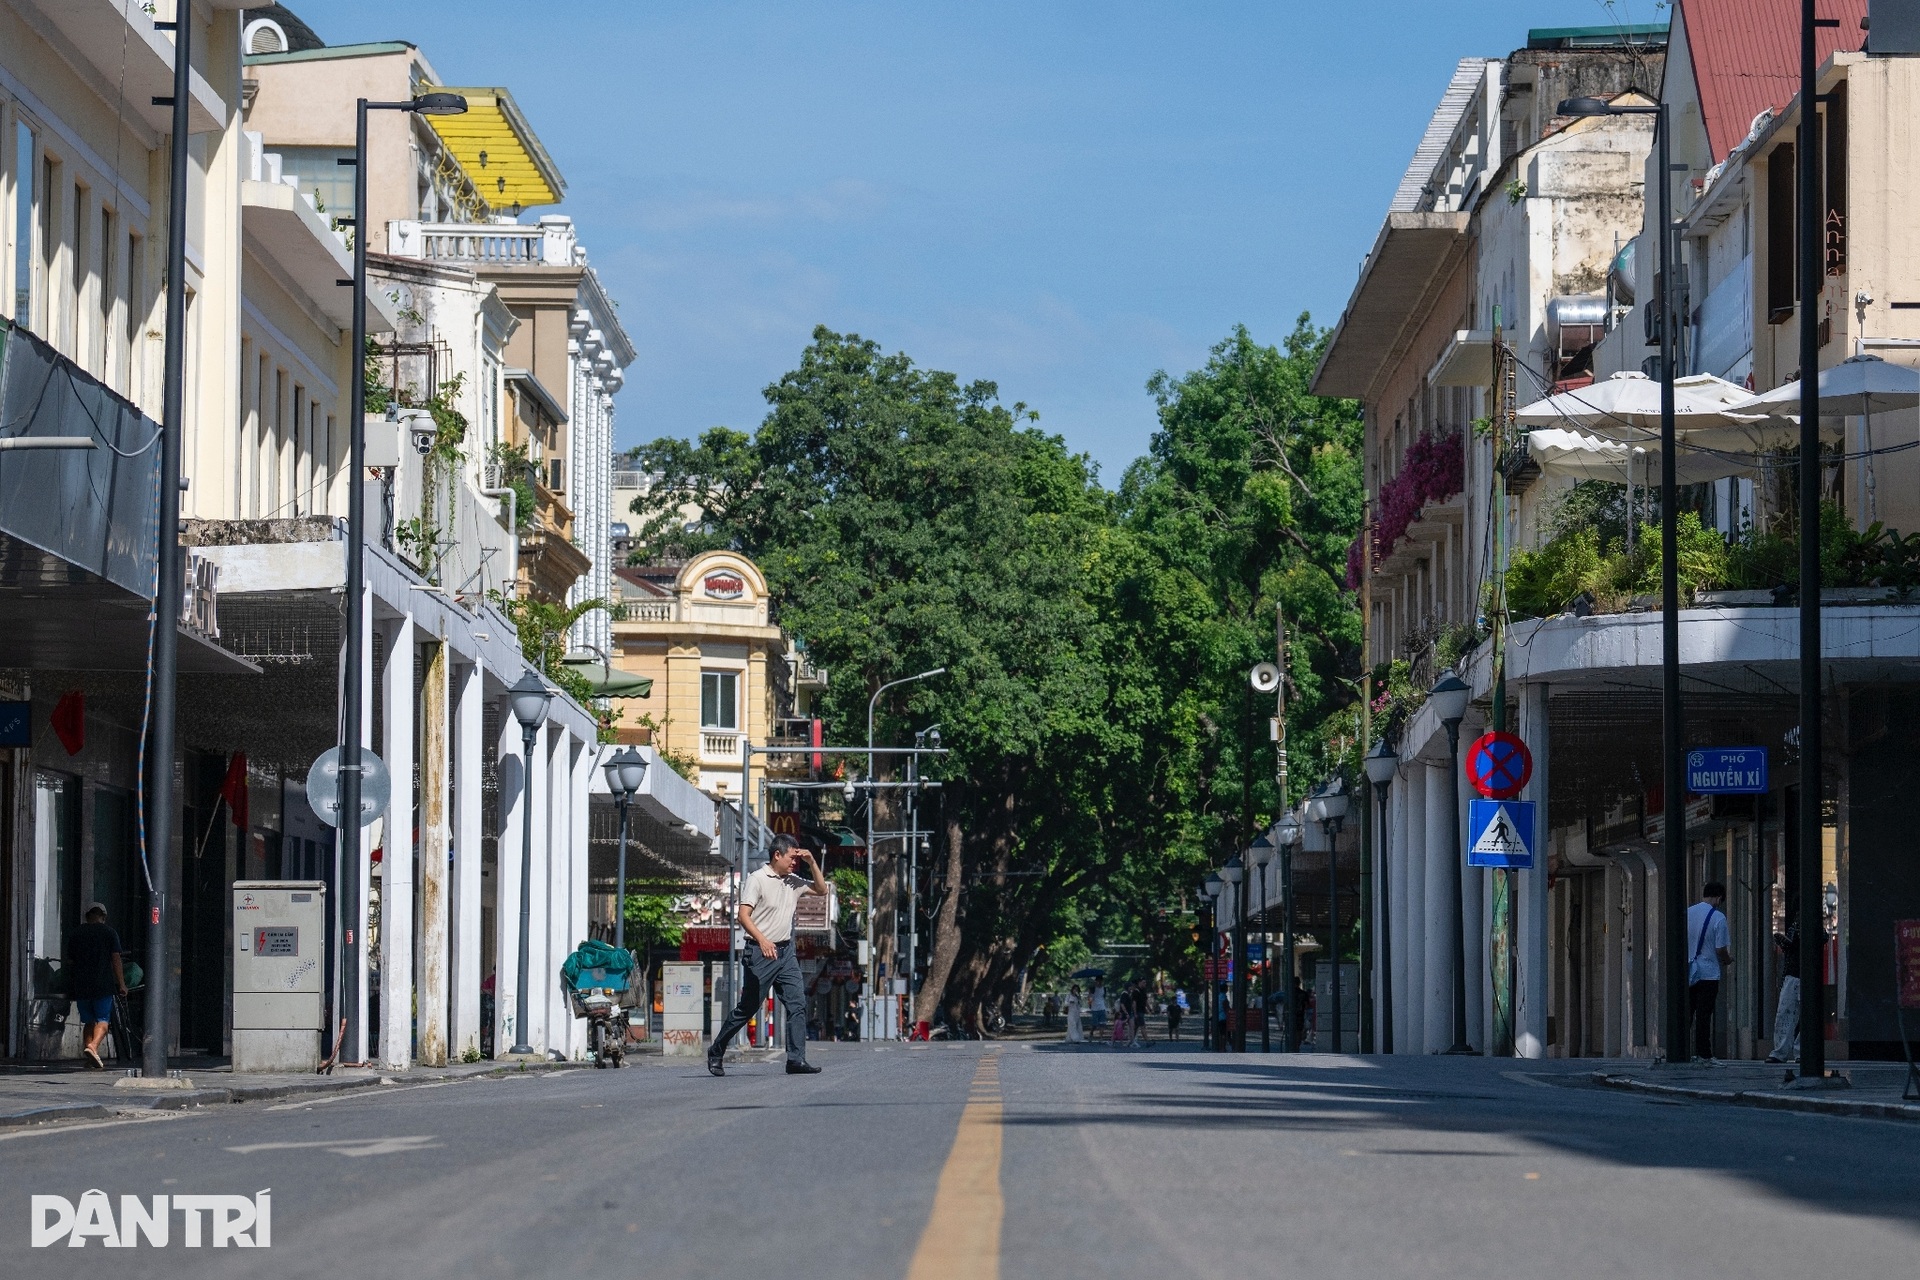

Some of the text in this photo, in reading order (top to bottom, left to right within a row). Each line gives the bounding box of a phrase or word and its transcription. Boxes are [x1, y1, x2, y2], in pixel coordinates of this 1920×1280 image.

[1720, 752, 1746, 763] PHỐ
[1692, 765, 1760, 788] NGUYỄN XÍ
